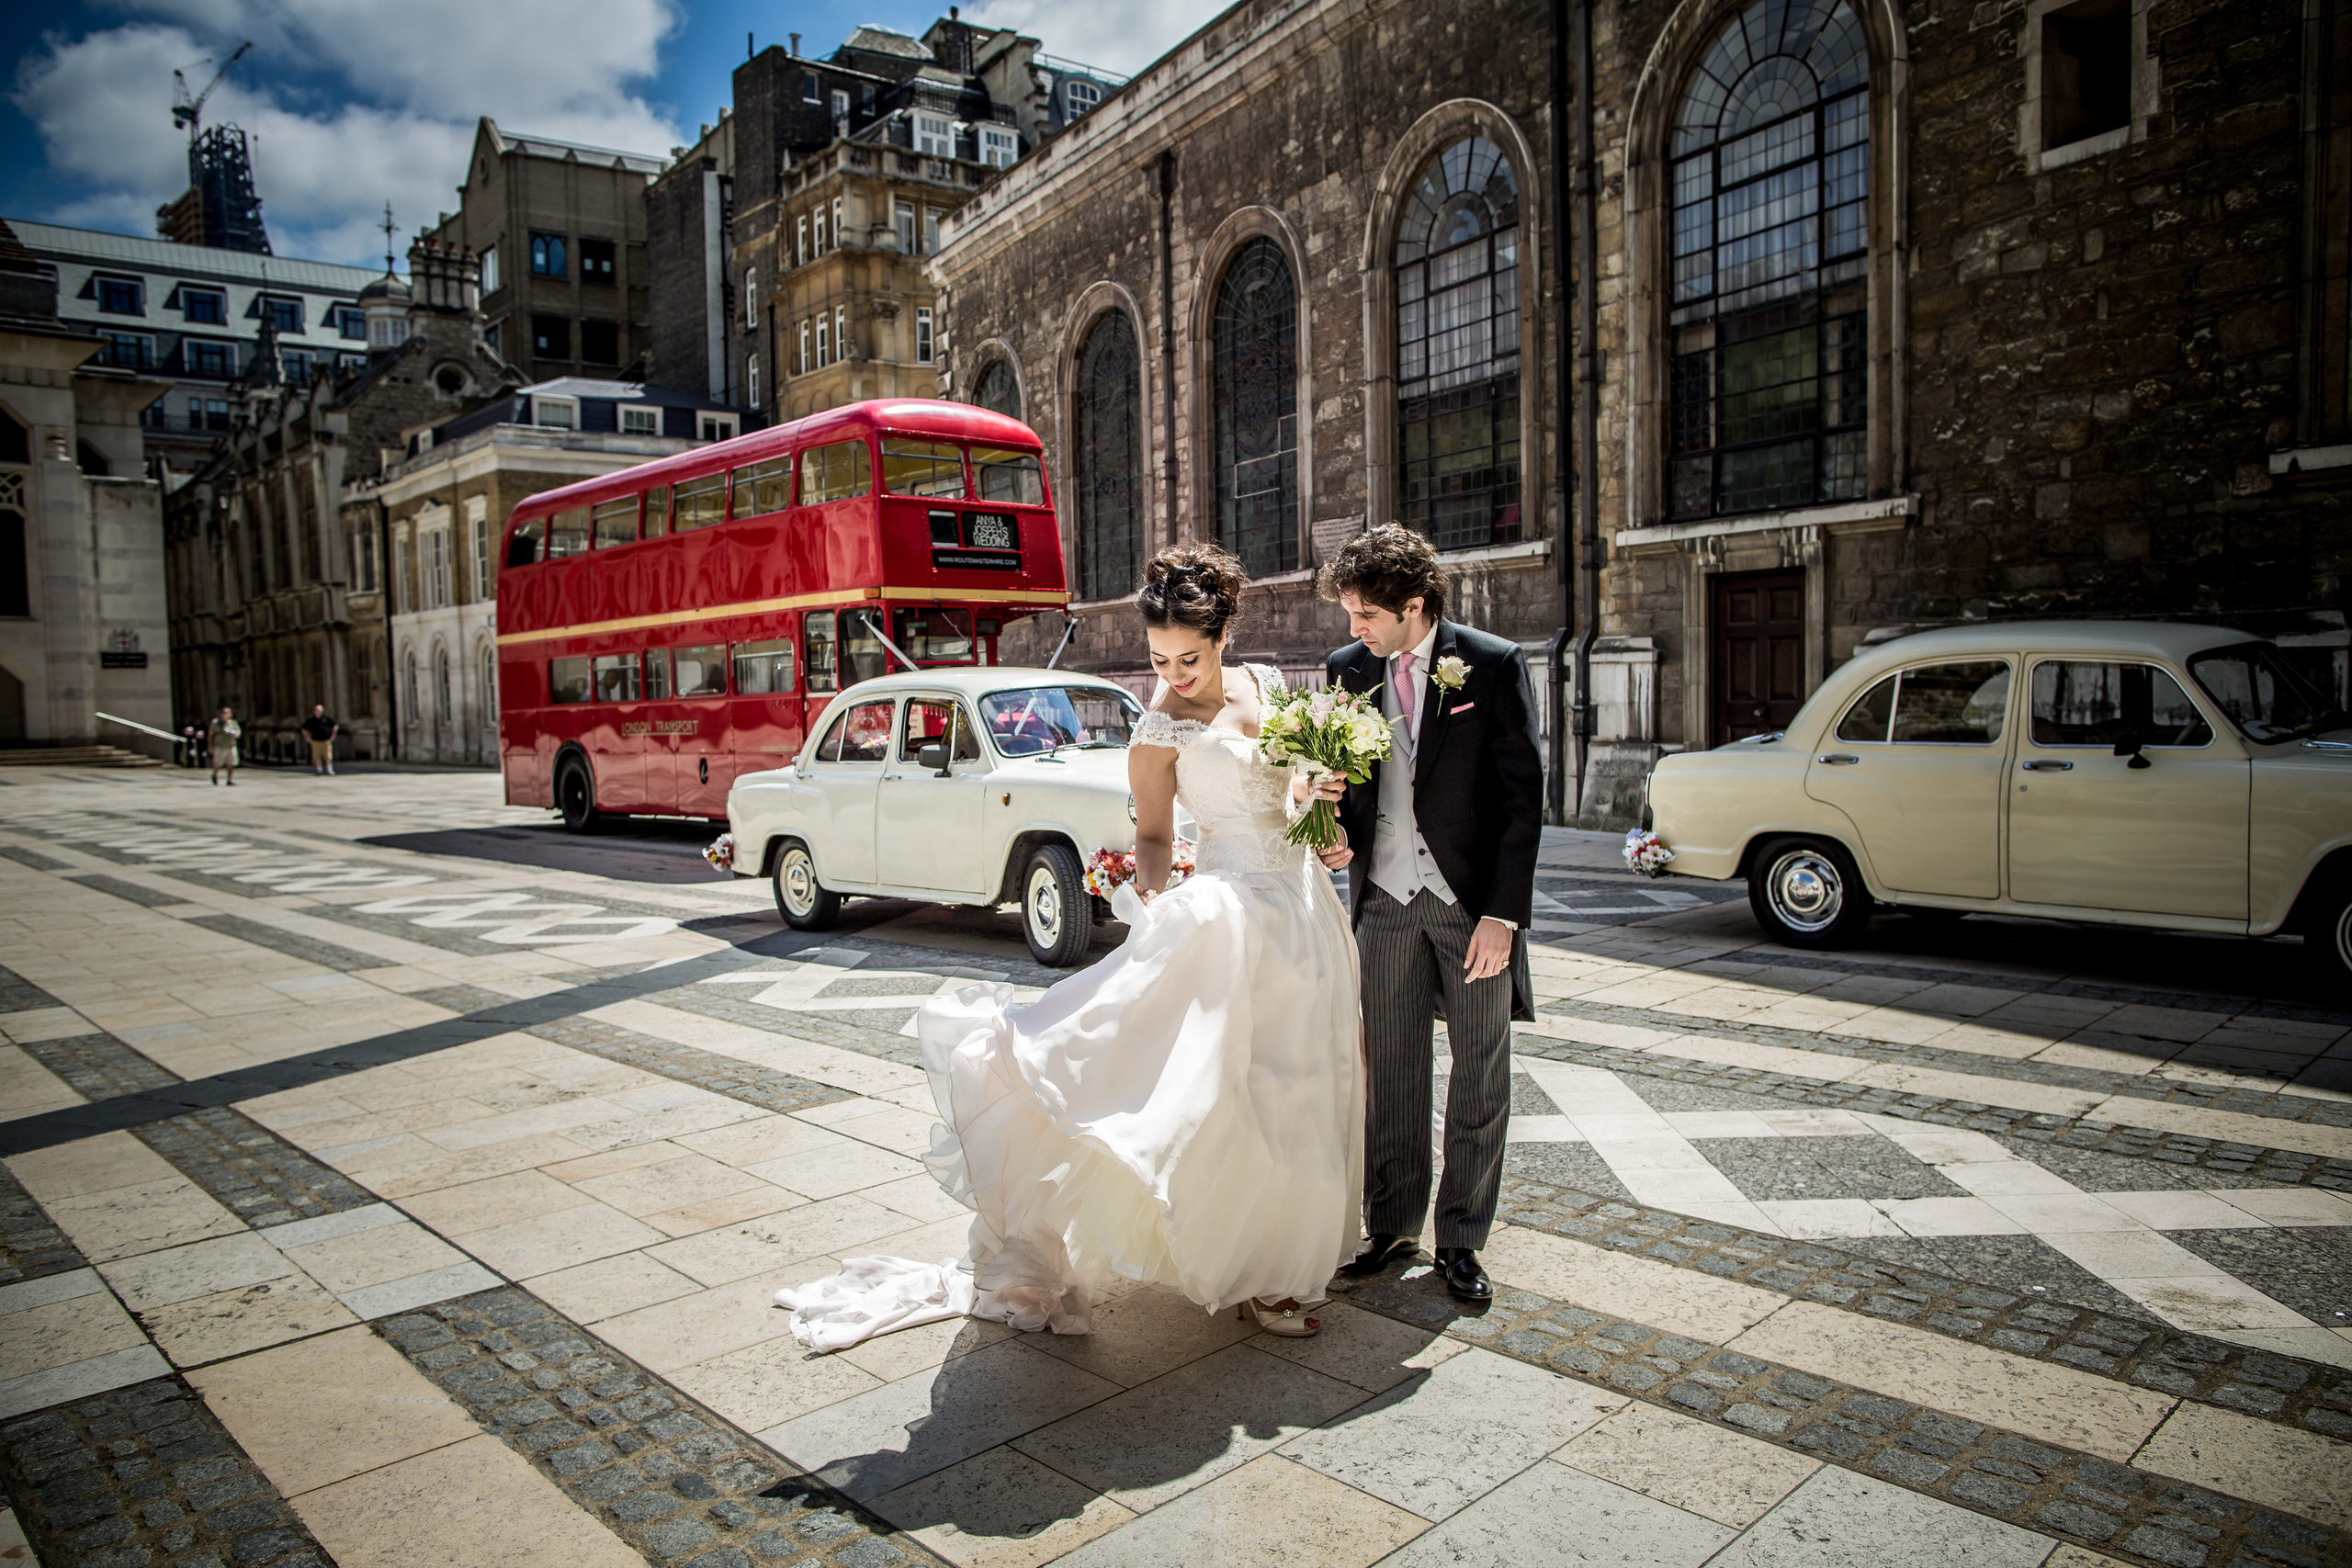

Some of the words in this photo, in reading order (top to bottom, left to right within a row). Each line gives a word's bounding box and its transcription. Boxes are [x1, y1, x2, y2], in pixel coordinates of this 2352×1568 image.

[976, 514, 996, 525] ANYA
[997, 516, 1003, 527] &
[973, 535, 1010, 547] WEDDING
[938, 557, 1017, 565] WWW.ROUTEMASTERHIRE.COM
[621, 721, 651, 737] LONDON
[655, 720, 698, 735] TRANSPORT
